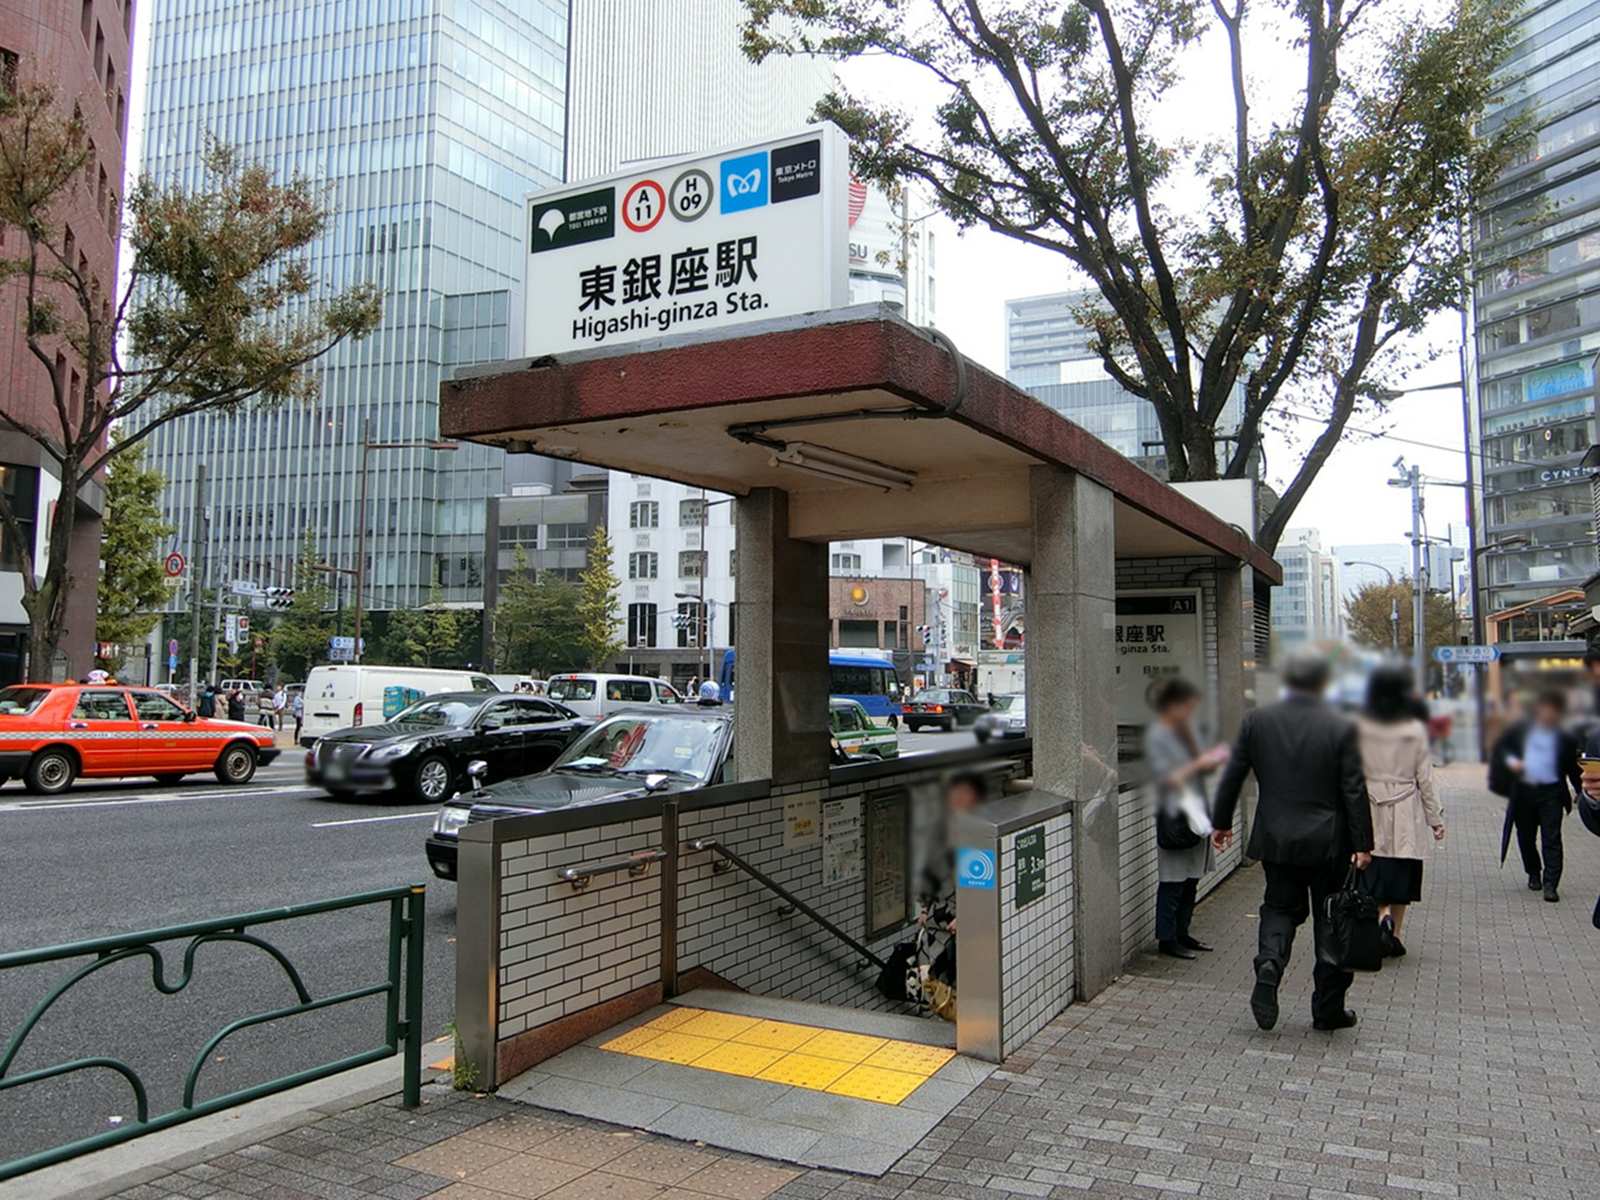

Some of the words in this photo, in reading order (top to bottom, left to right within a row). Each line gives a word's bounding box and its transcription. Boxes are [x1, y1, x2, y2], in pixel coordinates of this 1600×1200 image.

[775, 159, 816, 177] 東京メトロ
[686, 178, 698, 193] H
[777, 175, 796, 184] Tokyo
[796, 170, 814, 180] Metro
[638, 189, 650, 204] A
[680, 193, 702, 212] 09
[568, 205, 608, 222] 都営地下鉄
[635, 204, 652, 222] 11
[568, 221, 582, 231] TOEI
[583, 216, 609, 228] SUBWAY
[578, 236, 758, 312] 東銀座駅
[572, 300, 719, 342] Higashi-ginza
[726, 291, 769, 315] Sta.
[1151, 645, 1170, 653] Sta.
